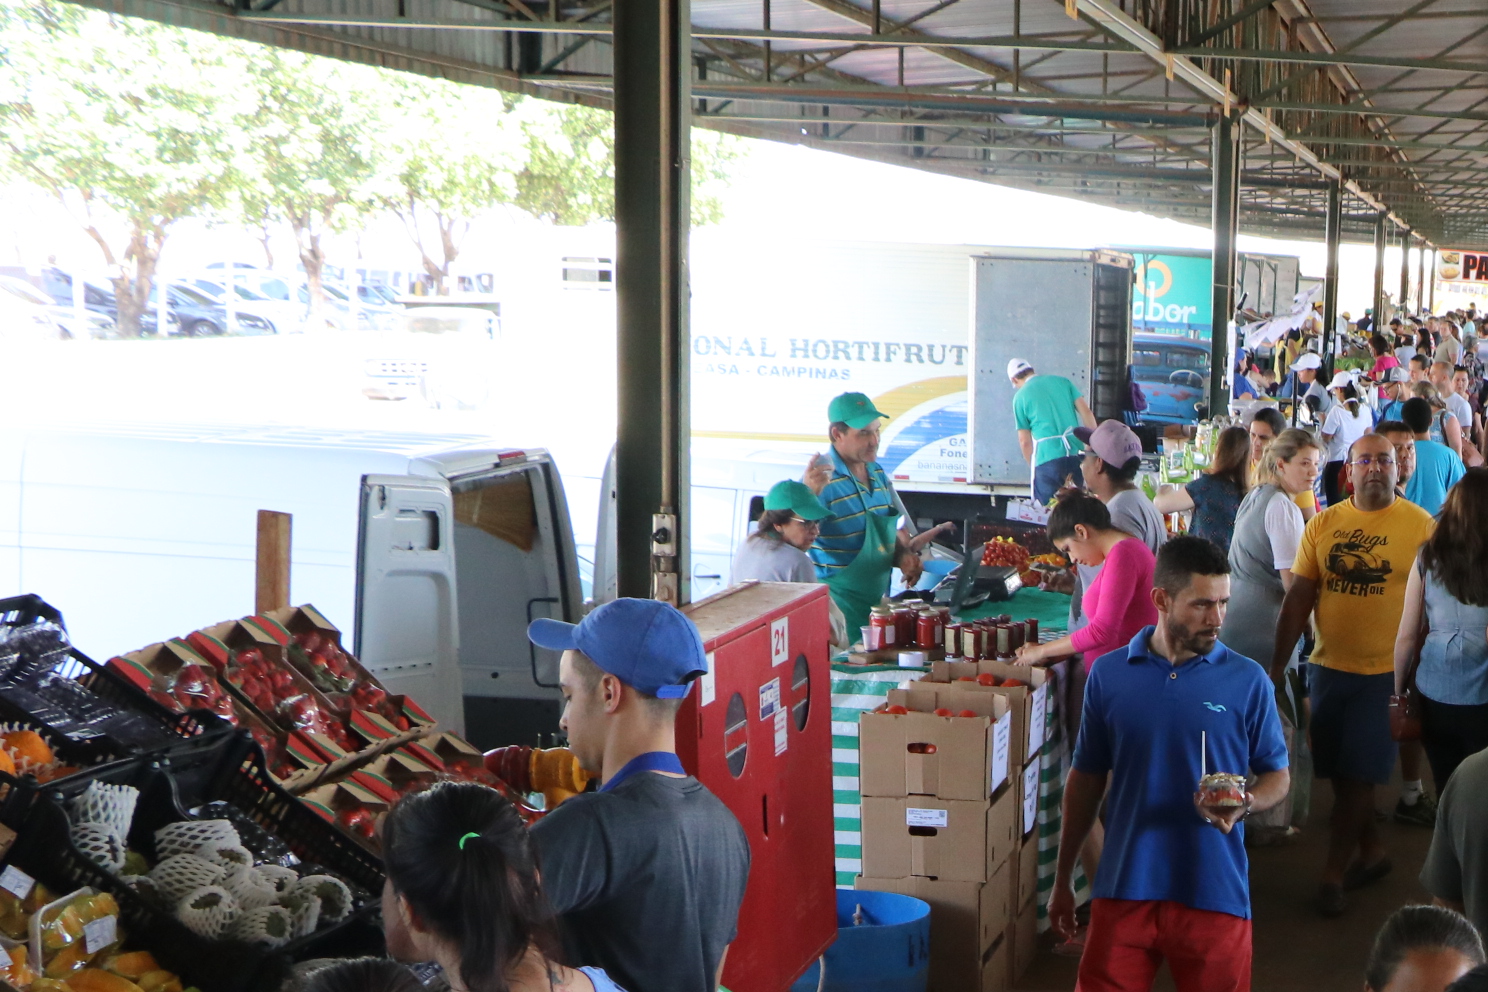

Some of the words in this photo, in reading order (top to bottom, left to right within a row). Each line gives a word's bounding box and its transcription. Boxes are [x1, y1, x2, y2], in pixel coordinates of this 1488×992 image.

[693, 335, 777, 358] ONAL
[757, 365, 850, 381] CAMPINAS
[1333, 530, 1350, 540] Old
[1348, 529, 1389, 553] Bugs
[1326, 576, 1369, 597] NEVER
[1369, 586, 1385, 596] DIE
[774, 625, 786, 656] 21
